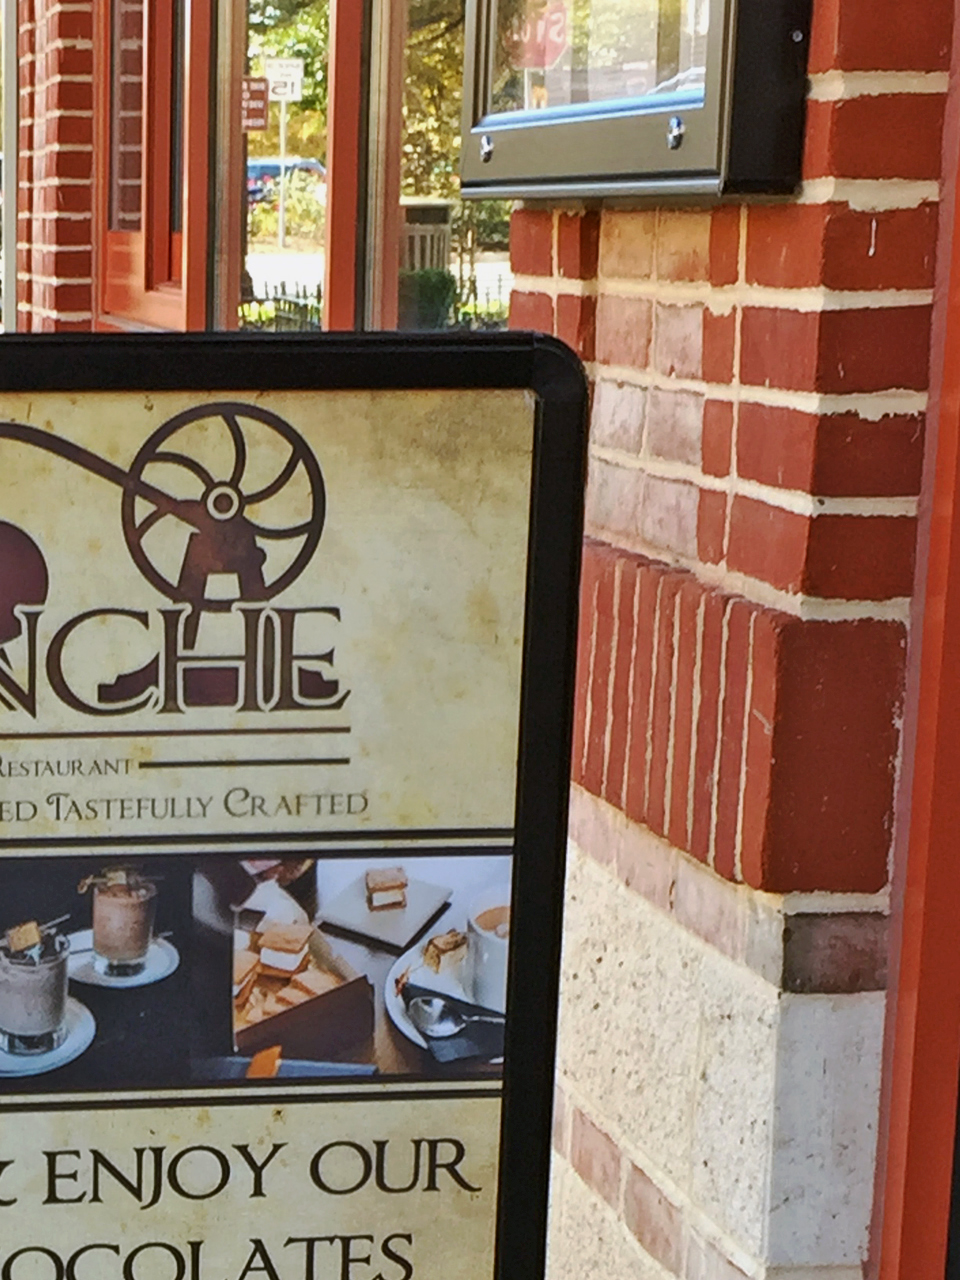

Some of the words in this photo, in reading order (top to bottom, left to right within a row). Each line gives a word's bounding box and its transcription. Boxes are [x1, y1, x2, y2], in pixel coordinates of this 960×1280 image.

[46, 793, 209, 820] TASTEFULLY
[224, 788, 368, 817] CRAFTED
[43, 1143, 288, 1210] ENJOY
[310, 1138, 482, 1195] OUR
